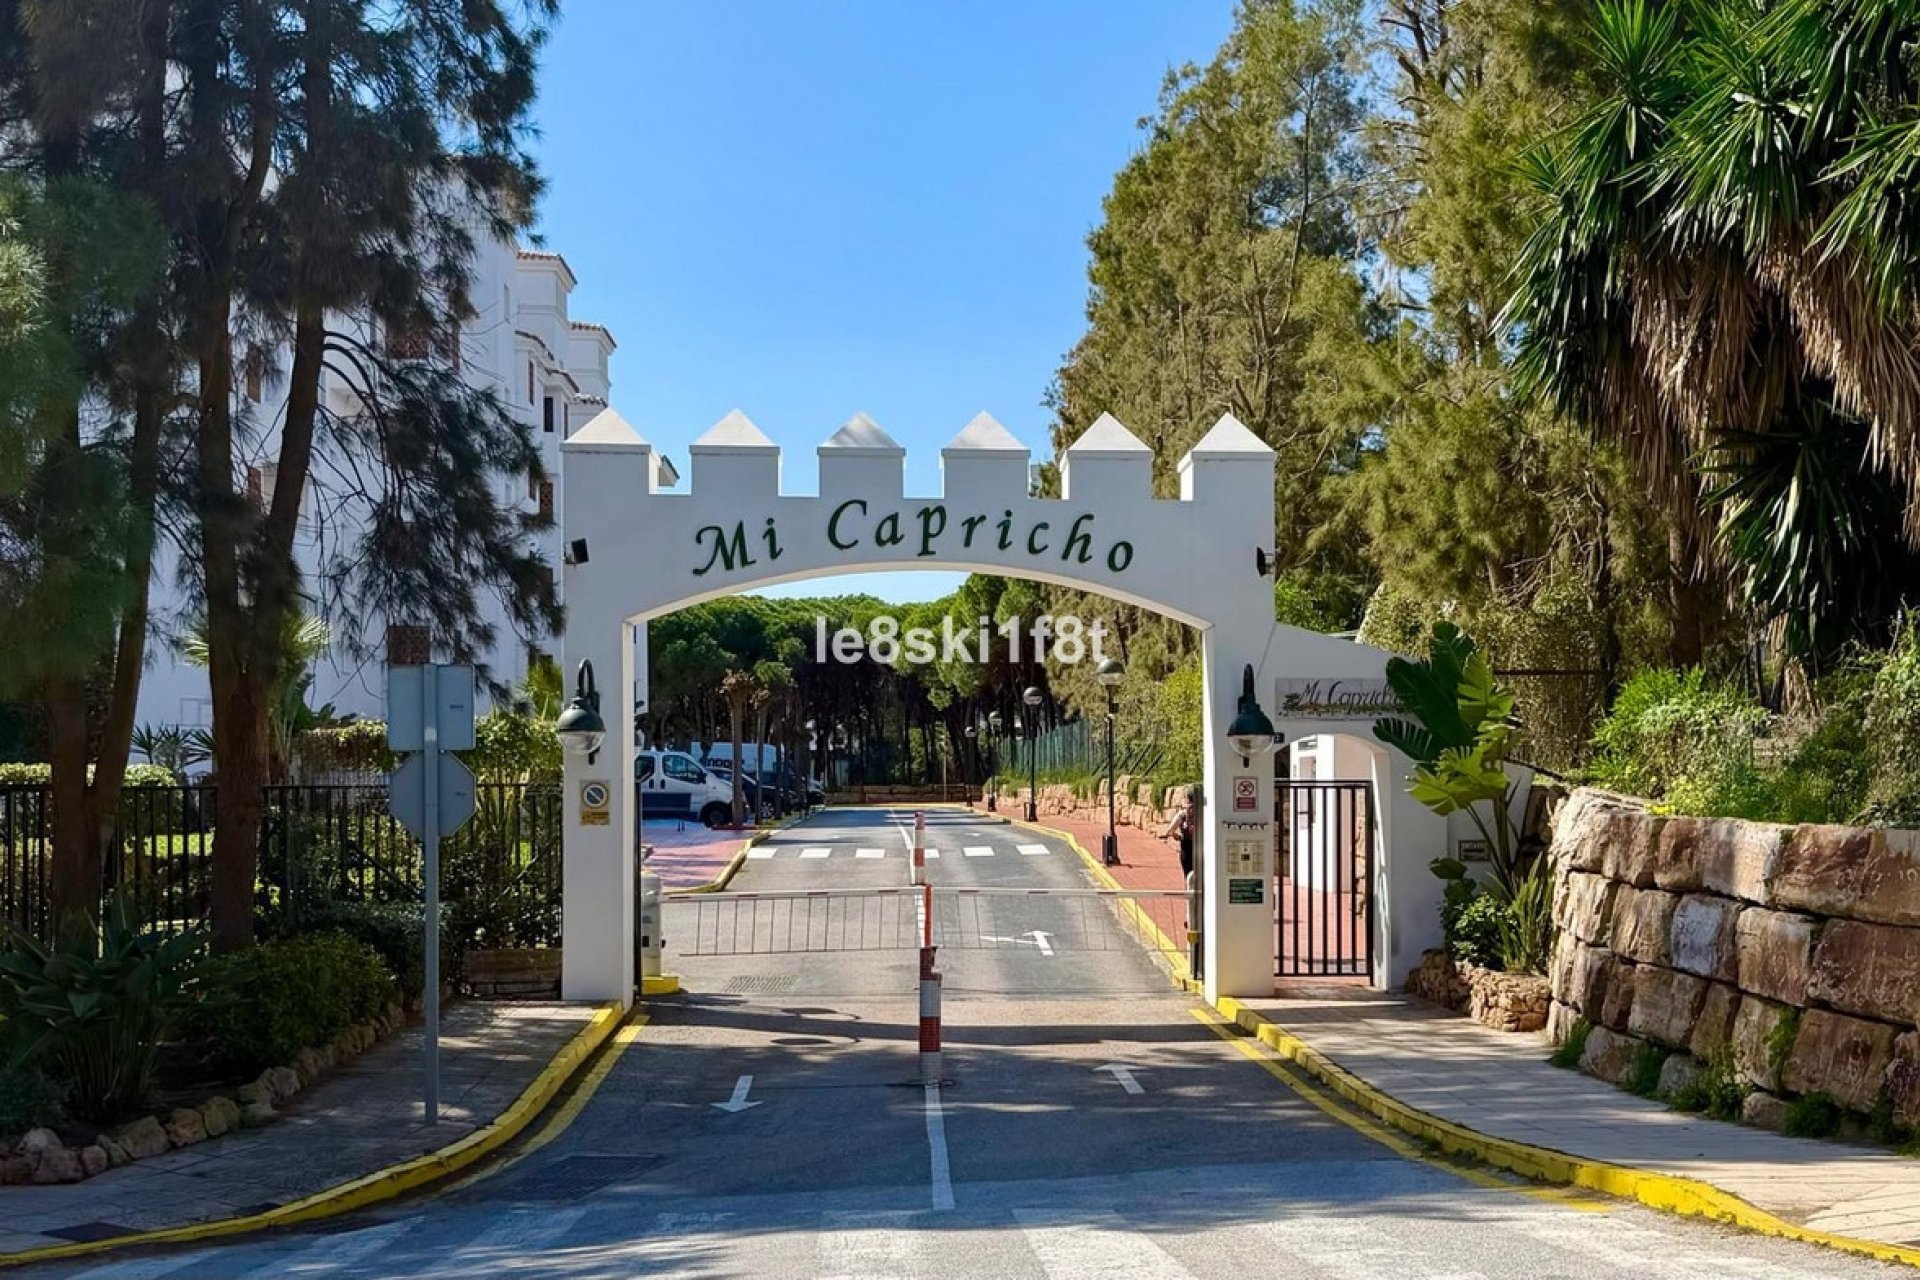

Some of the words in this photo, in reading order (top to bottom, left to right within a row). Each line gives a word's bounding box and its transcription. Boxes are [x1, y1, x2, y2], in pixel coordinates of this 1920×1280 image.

[692, 517, 784, 576] Mi
[827, 499, 1135, 573] Capricho
[1299, 679, 1322, 706] Mi
